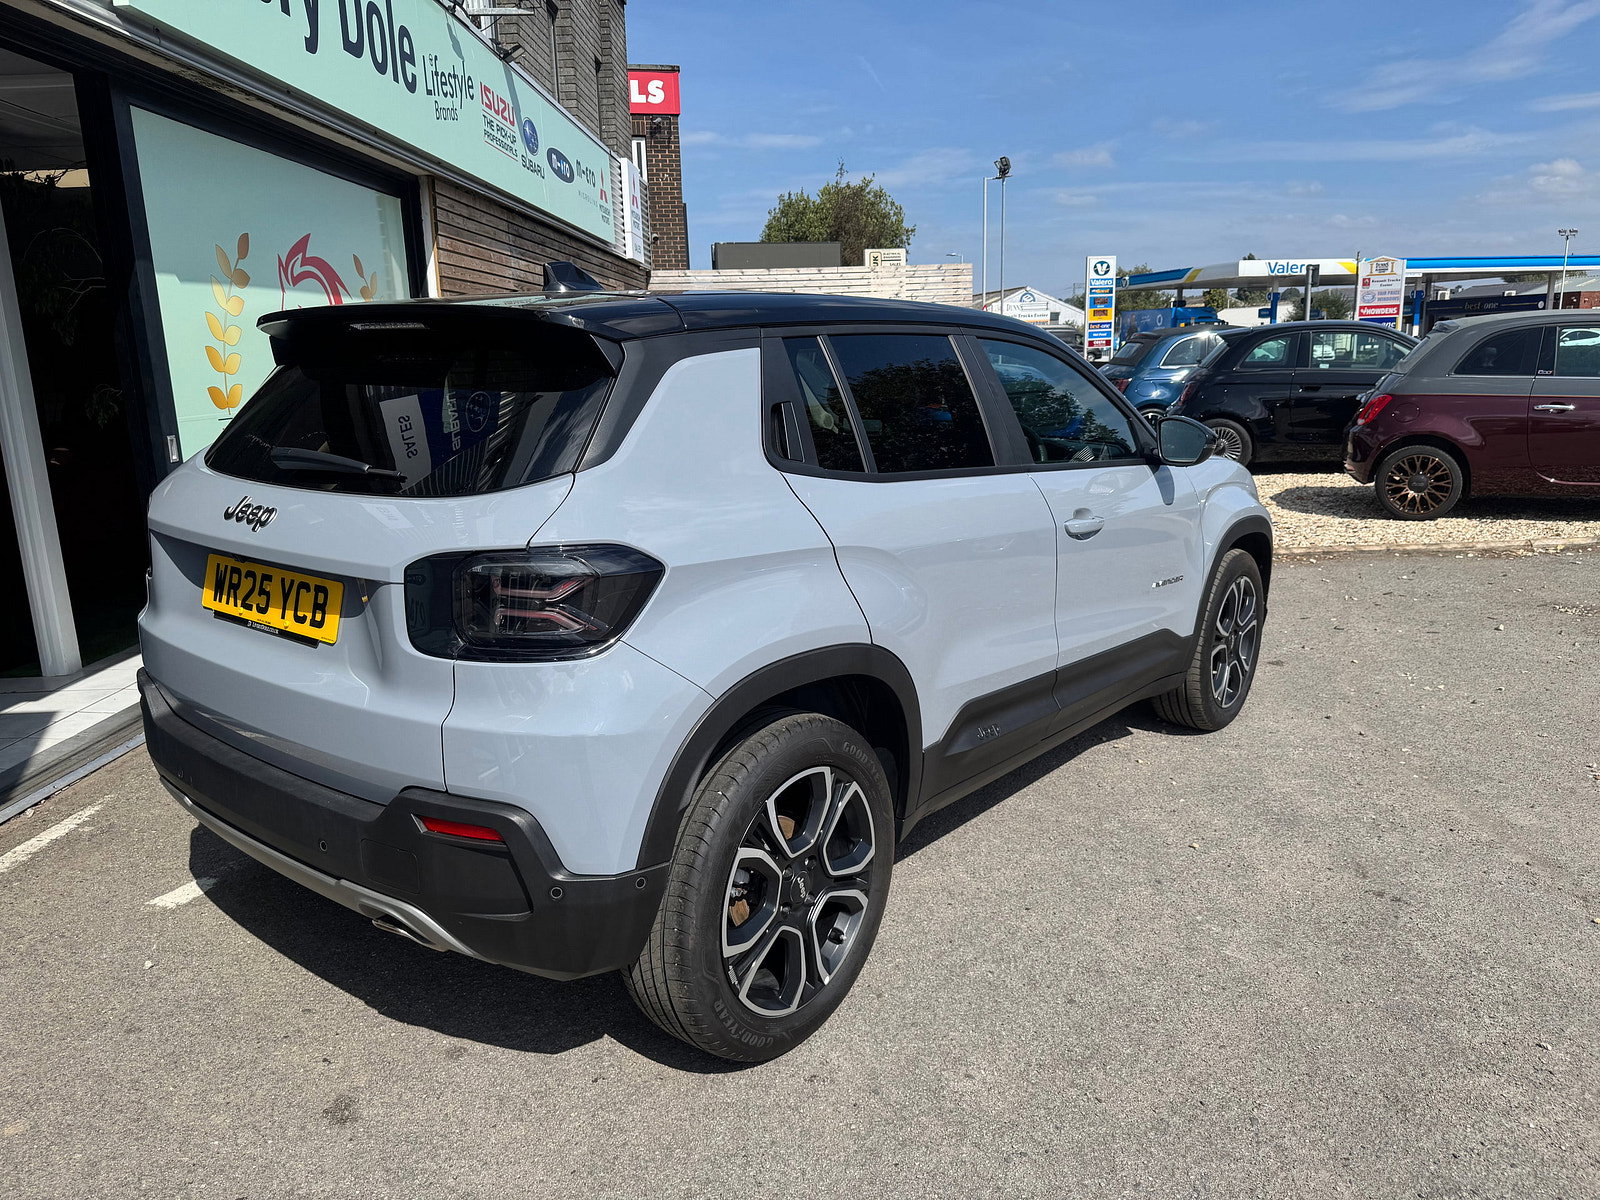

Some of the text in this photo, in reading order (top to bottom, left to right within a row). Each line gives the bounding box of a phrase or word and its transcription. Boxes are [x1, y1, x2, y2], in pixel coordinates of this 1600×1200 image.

[422, 53, 475, 109] Lifestyle
[630, 79, 665, 104] LS
[434, 100, 459, 121] Brands
[480, 81, 516, 127] ISUZU
[482, 114, 517, 147] THE PICK-UP
[483, 129, 518, 158] PROFESSIONALS
[521, 154, 545, 180] SUBARU
[1267, 261, 1312, 274] Valer
[1365, 307, 1398, 315] HOWDENS
[223, 495, 278, 533] Jeep
[213, 562, 329, 629] WR25 YCB
[976, 724, 1000, 739] Jeep
[796, 876, 806, 898] Jeep
